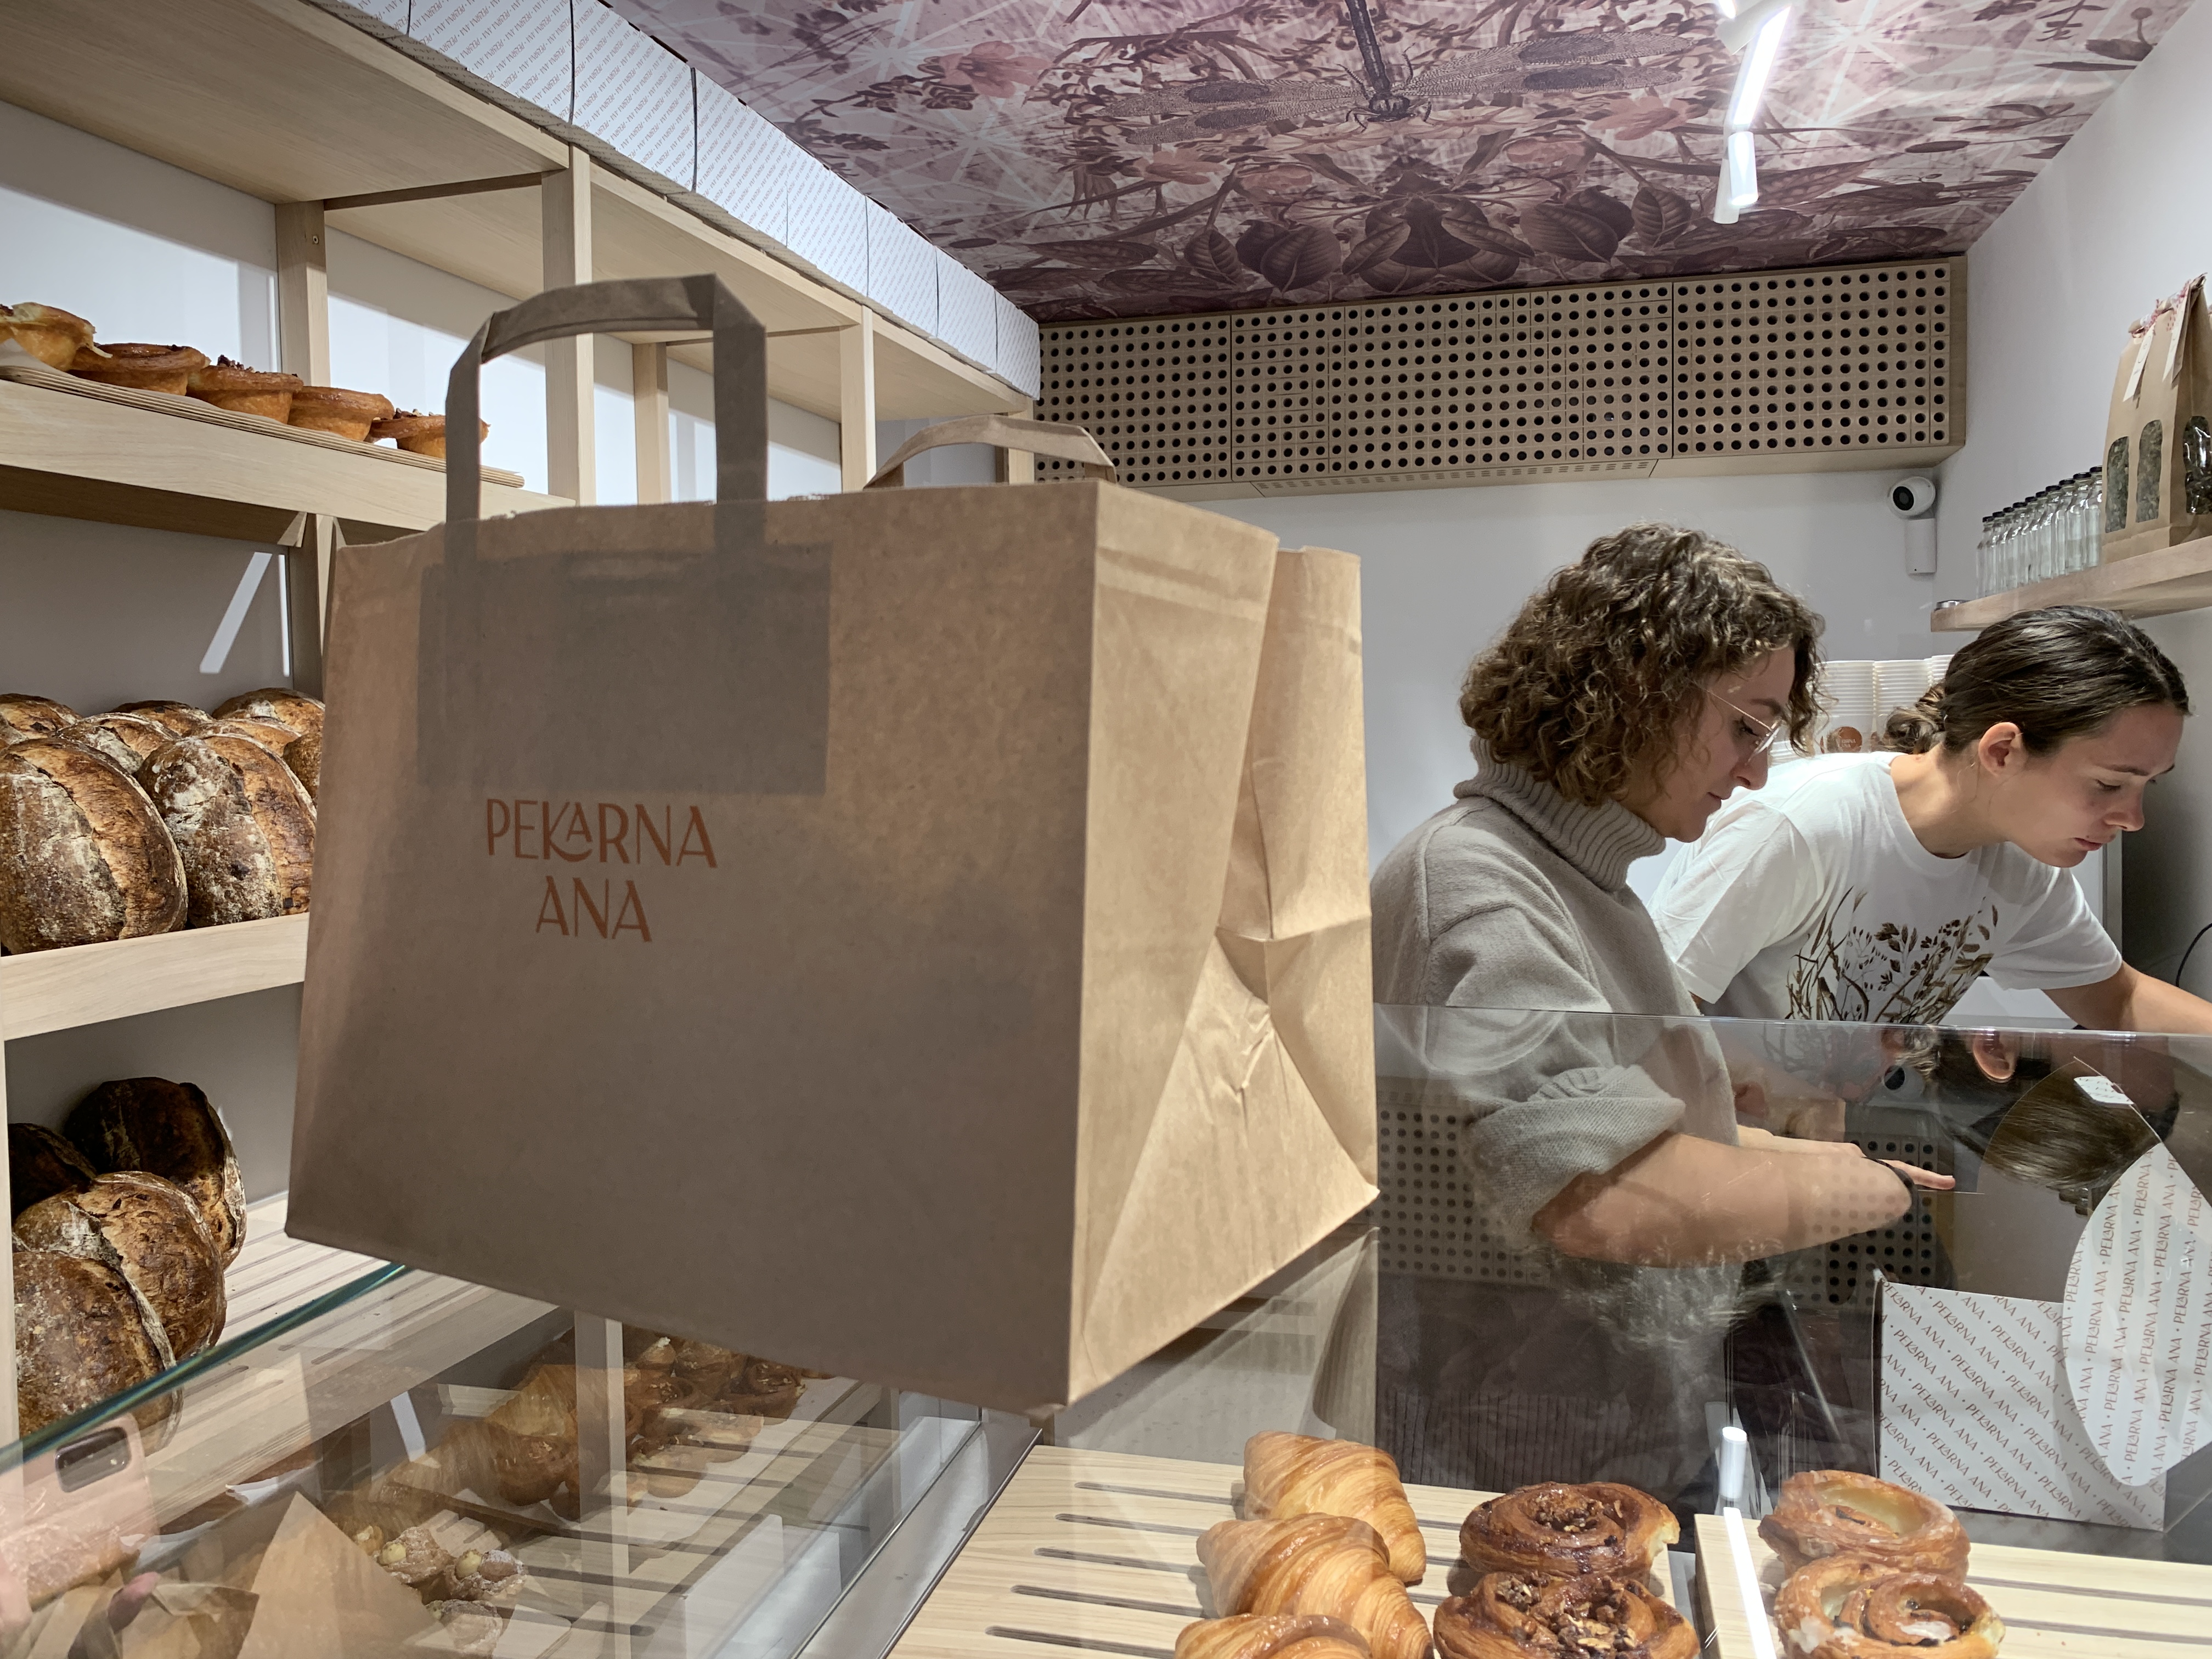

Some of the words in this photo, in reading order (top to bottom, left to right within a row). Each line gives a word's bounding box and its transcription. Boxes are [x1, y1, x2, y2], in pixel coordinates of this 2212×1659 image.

[439, 35, 458, 53] PEKARN
[487, 799, 718, 868] PEKARNA
[536, 876, 652, 942] ANA
[2108, 1178, 2121, 1201] AN
[2134, 1164, 2152, 1216] PEKARNA
[2162, 1184, 2176, 1210] ANA
[2187, 1186, 2202, 1226] PEKAR
[2100, 1205, 2118, 1257] PEKARNA
[2128, 1230, 2142, 1256] ANA
[2154, 1215, 2172, 1267] PEKARNA
[2065, 1250, 2083, 1302] PEKARNA
[2094, 1271, 2108, 1296] ANA
[2119, 1261, 2137, 1313] PEKARNA
[2148, 1281, 2163, 1307] ANA
[2174, 1271, 2192, 1324] PEKARNA
[1961, 1297, 1985, 1319] ANA
[1991, 1325, 2035, 1370] PEKARNA
[2034, 1370, 2058, 1393] ANA
[2016, 1317, 2040, 1340] ANA
[2085, 1301, 2103, 1354] PEKARNA
[2113, 1327, 2128, 1353] ANA
[2140, 1312, 2158, 1364] PEKARNA
[2168, 1338, 2182, 1364] ANA
[2193, 1323, 2212, 1375] PEKARNA
[1883, 1282, 1922, 1325] PEKARNA
[1921, 1325, 1945, 1349] ANA
[1951, 1354, 1995, 1399] PEKARNA
[1994, 1400, 2018, 1423] ANA
[2023, 1427, 2068, 1471] PEKARNA
[2067, 1471, 2090, 1494] ANA
[2096, 1498, 2132, 1528] PEKAR
[2079, 1367, 2094, 1392] ANA
[2104, 1358, 2123, 1410] PEKARNA
[2134, 1378, 2148, 1404] ANA
[2159, 1369, 2178, 1422] PEKARNA
[2188, 1389, 2203, 1415] ANA
[1882, 1354, 1906, 1377] ANA
[1912, 1383, 1955, 1428] PEKARNA
[1954, 1428, 1978, 1451] ANA
[1984, 1456, 2027, 1499] PEKARNA
[1894, 1329, 1937, 1375] PEKARNA
[1936, 1375, 1960, 1398] ANA
[1965, 1403, 2009, 1448] PEKARNA
[2008, 1448, 2032, 1471] ANA
[2038, 1476, 2081, 1518] PEKARNA
[1932, 1301, 1976, 1346] PEKARNA
[1976, 1346, 2000, 1369] ANA
[2005, 1375, 2050, 1419] PEKARNA
[2049, 1419, 2073, 1442] ANA
[2123, 1491, 2146, 1513] ANA
[1897, 1404, 1920, 1426] ANA
[1926, 1432, 1969, 1476] PEKARNA
[1968, 1476, 1992, 1498] ANA
[2098, 1424, 2113, 1450] ANA
[2124, 1409, 2143, 1462] PEKARNA
[2153, 1435, 2168, 1462] ANA
[1888, 1460, 1929, 1496] PEKARN
[1915, 1456, 1939, 1479] ANA
